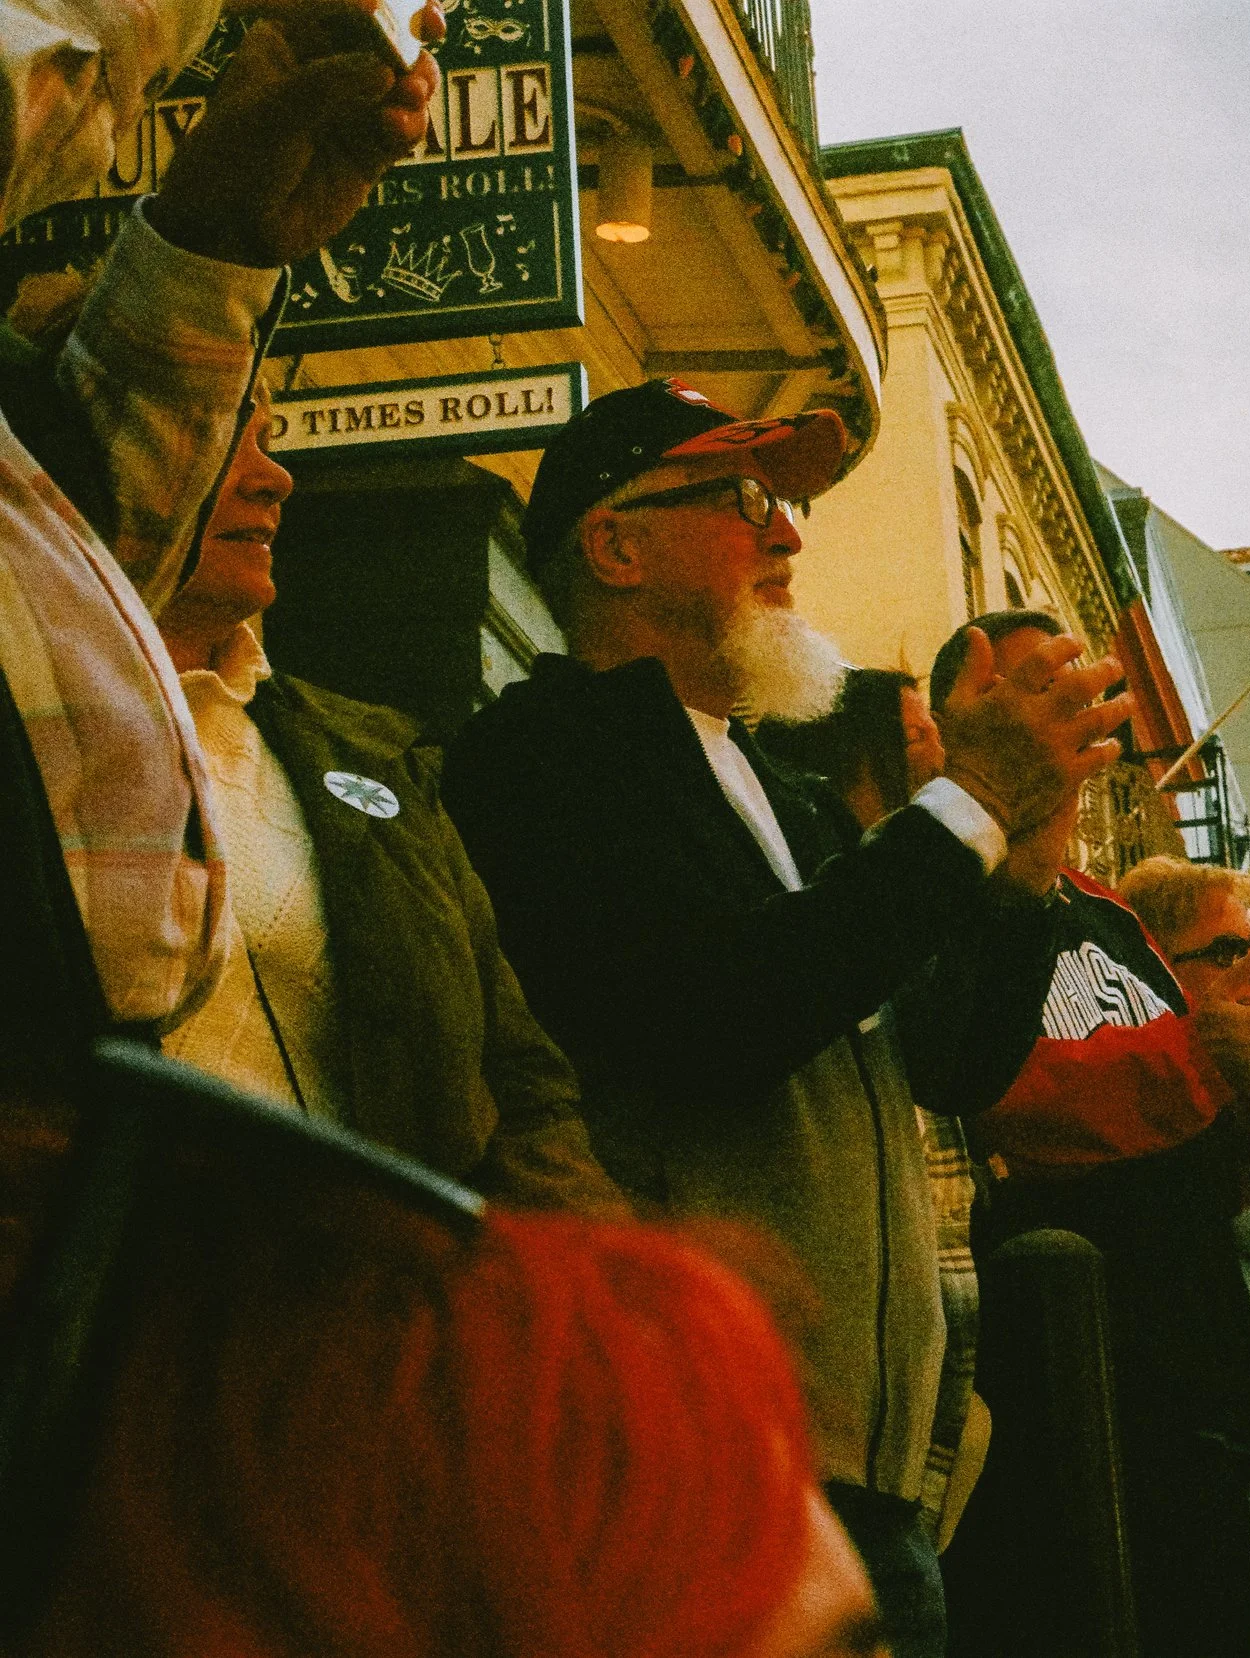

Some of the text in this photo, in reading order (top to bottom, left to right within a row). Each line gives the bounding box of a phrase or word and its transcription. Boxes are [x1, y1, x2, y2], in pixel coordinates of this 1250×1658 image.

[440, 164, 555, 201] ROLL!
[302, 400, 426, 436] TIMES
[439, 387, 555, 424] ROLL!
